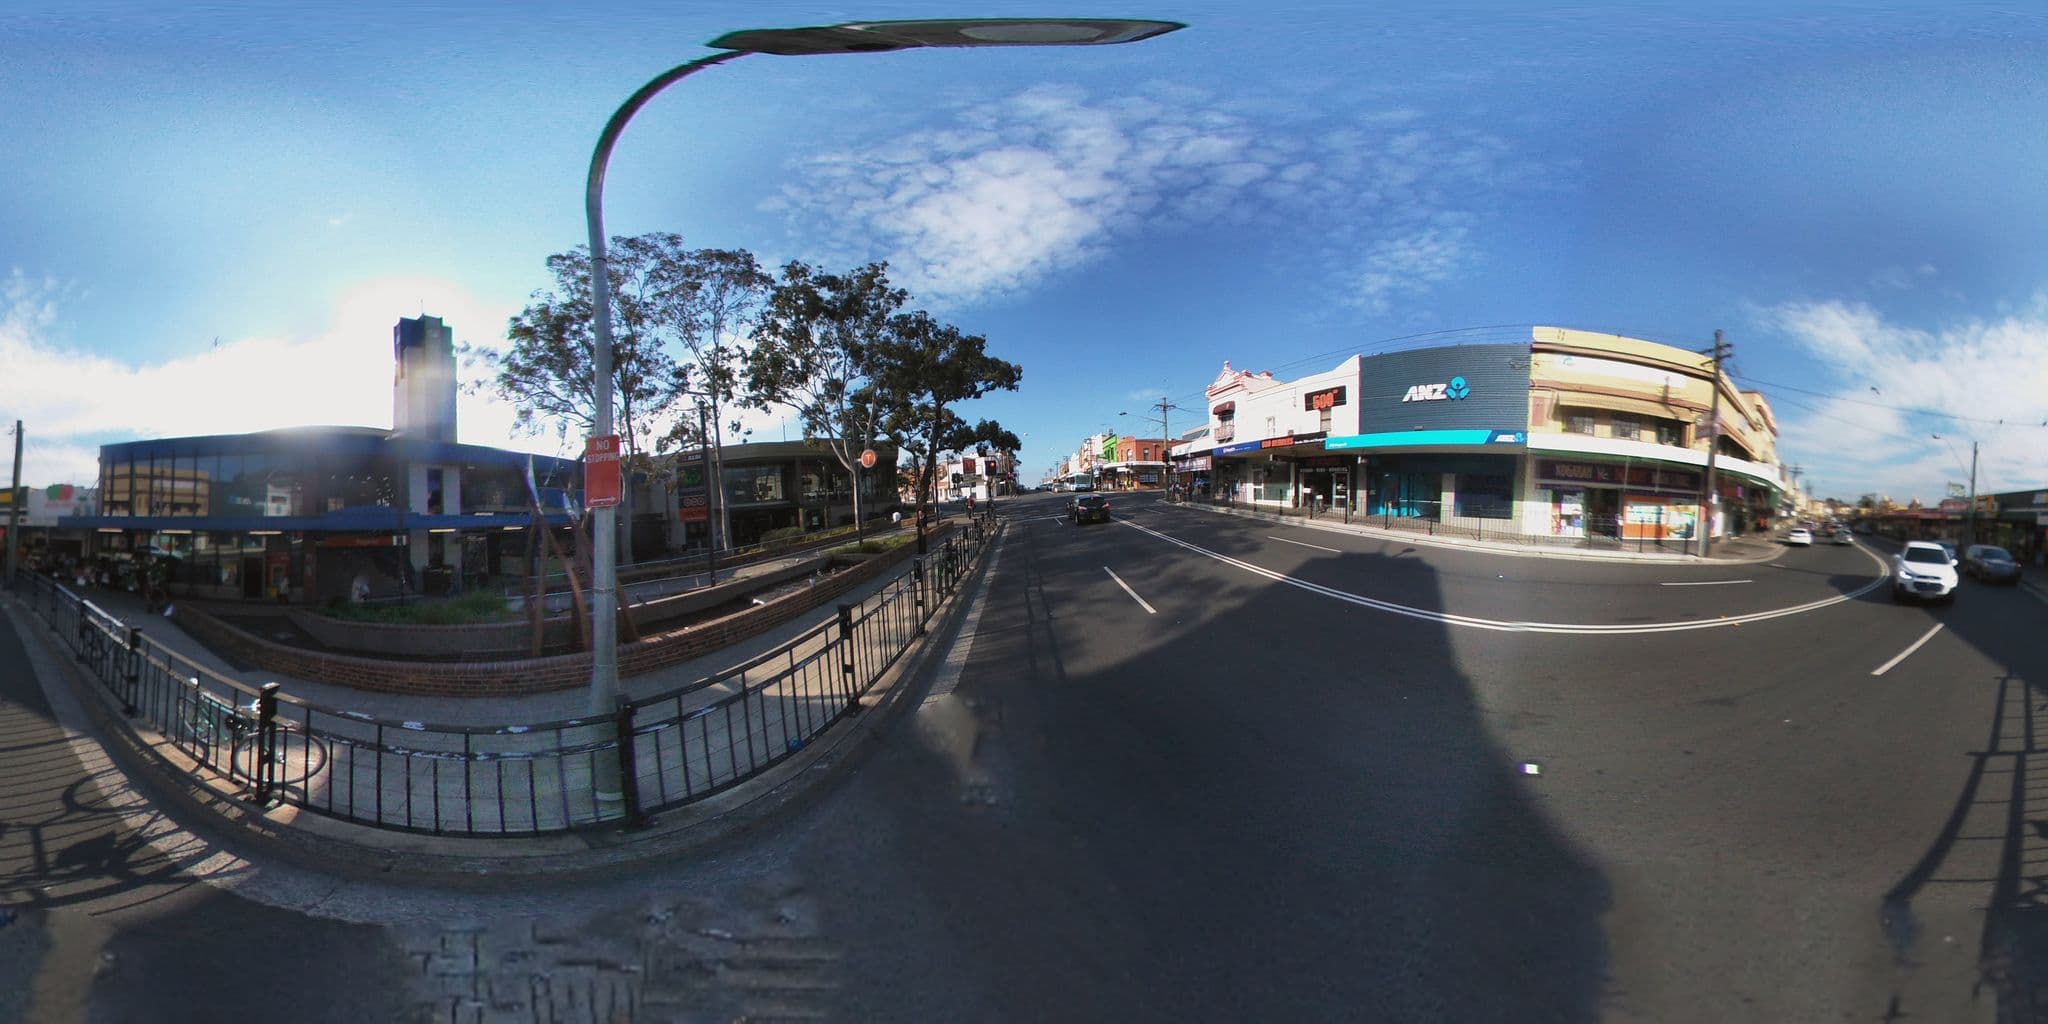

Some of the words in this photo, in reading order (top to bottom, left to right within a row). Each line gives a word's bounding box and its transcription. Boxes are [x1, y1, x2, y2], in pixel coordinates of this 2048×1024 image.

[1402, 384, 1448, 401] ANZ
[597, 440, 610, 450] NO
[587, 452, 620, 463] STOPPING
